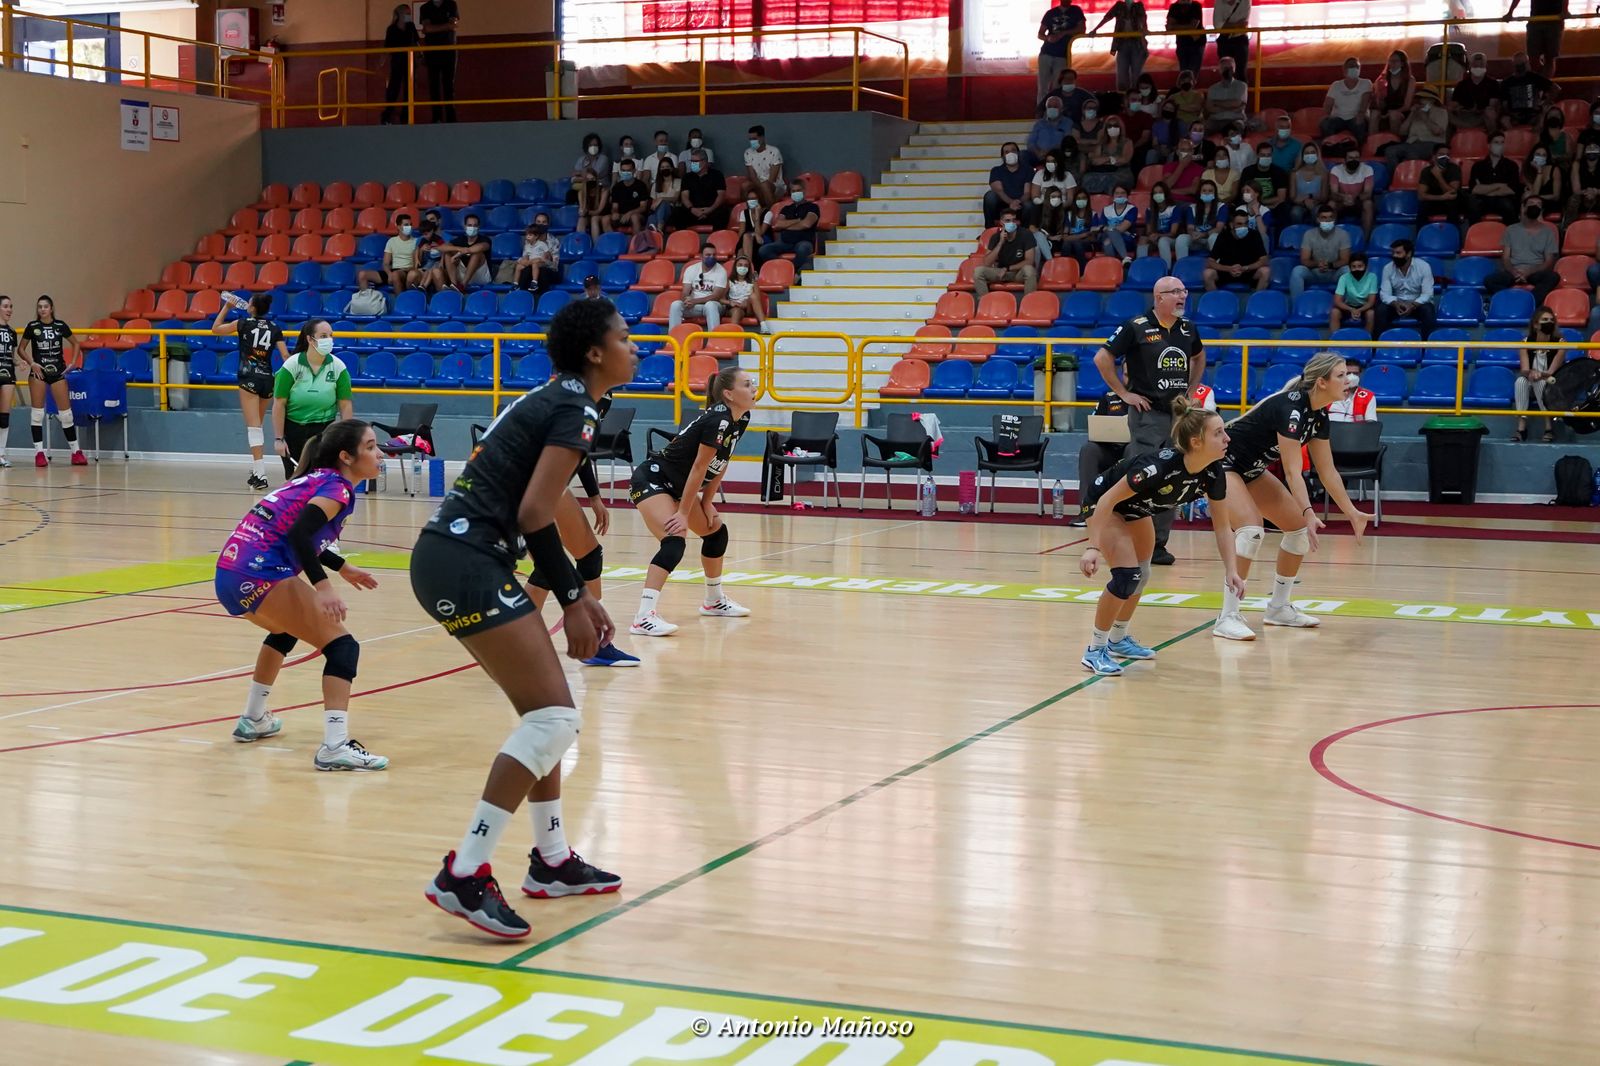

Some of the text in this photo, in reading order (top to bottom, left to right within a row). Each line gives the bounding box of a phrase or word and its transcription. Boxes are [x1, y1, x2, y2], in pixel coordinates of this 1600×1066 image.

[42, 329, 55, 340] 15
[251, 327, 272, 351] 14
[1162, 357, 1184, 368] SHC
[69, 391, 87, 400] lten
[239, 581, 272, 609] Divisa
[440, 611, 482, 633] Divisa
[1392, 603, 1600, 626] YTO
[0, 942, 320, 1023] DE
